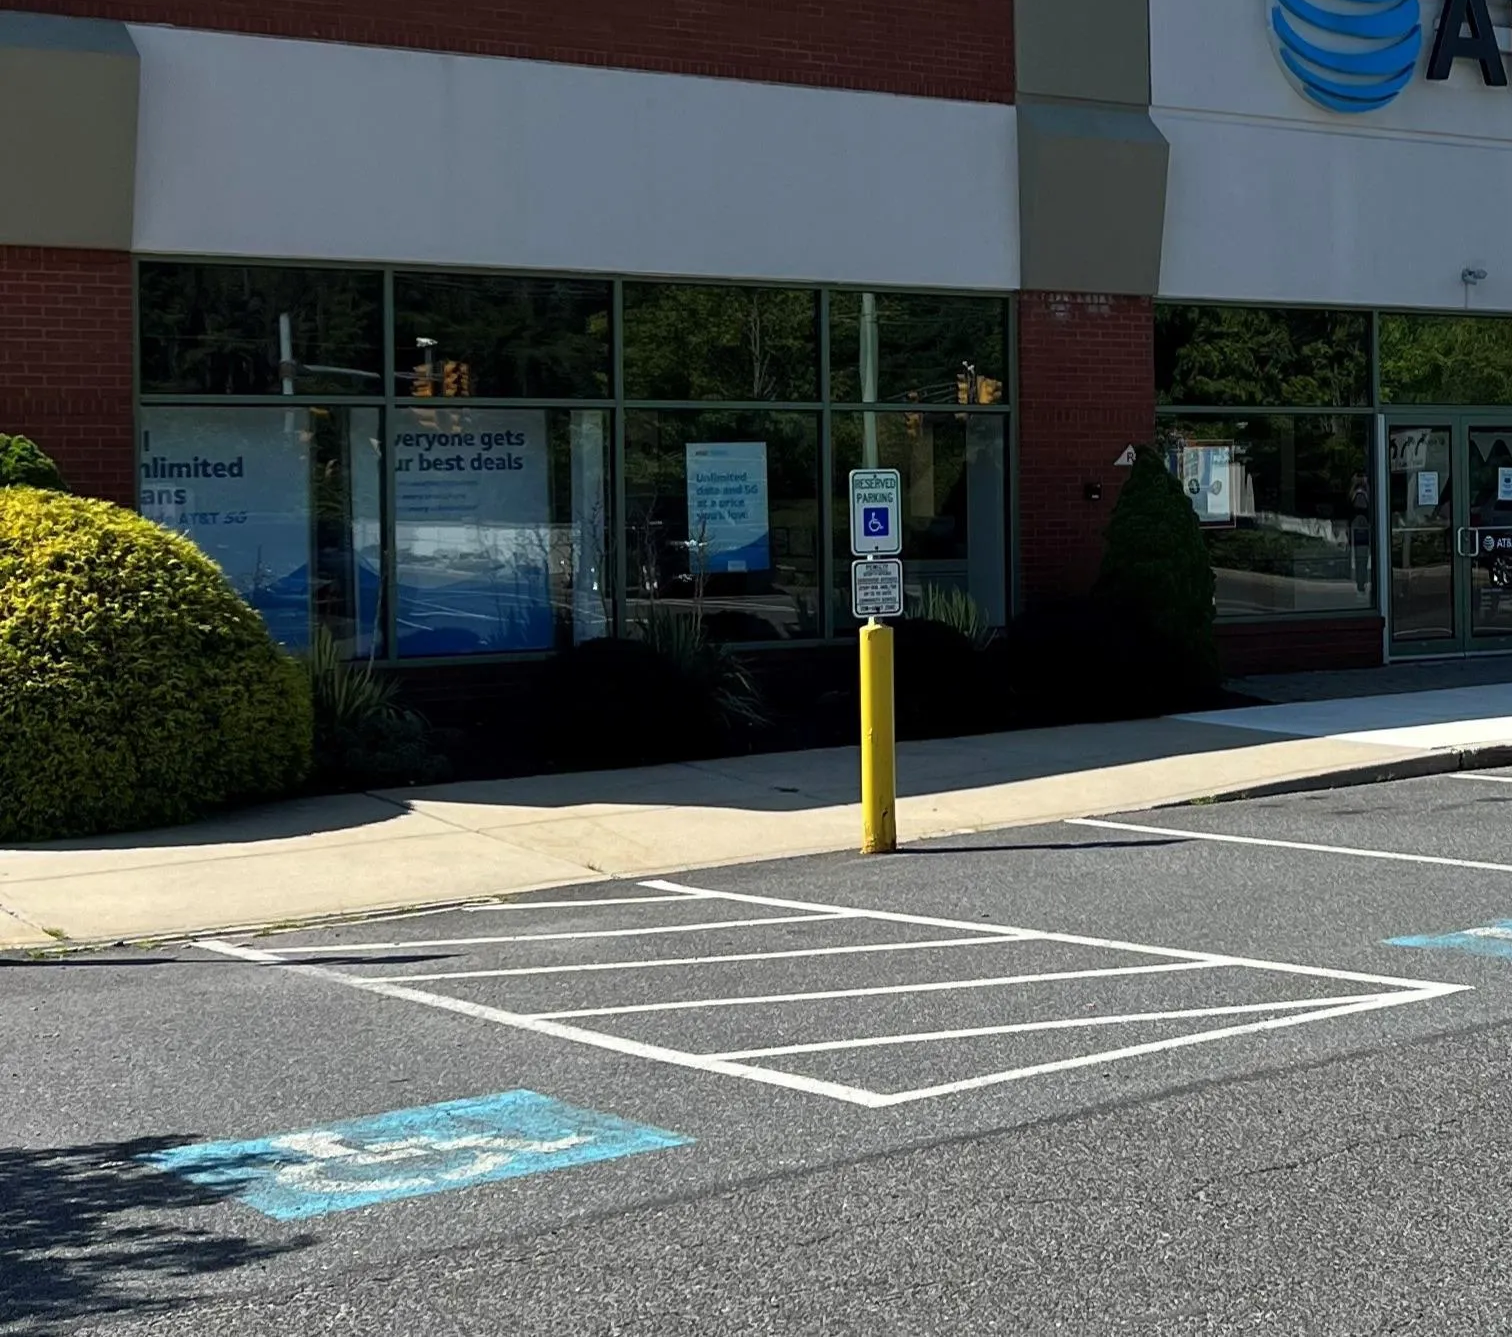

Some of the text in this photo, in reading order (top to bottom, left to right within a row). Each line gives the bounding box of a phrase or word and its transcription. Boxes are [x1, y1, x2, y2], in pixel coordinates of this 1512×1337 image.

[395, 430, 525, 451] veryone gets
[140, 456, 244, 478] nlimited
[418, 452, 465, 472] best
[470, 452, 524, 471] deals
[696, 472, 747, 483] Unlimited
[854, 478, 896, 490] RESERVED
[140, 489, 187, 505] ans
[744, 485, 759, 496] 5G
[857, 492, 894, 504] PARKING
[179, 512, 221, 525] AT&T
